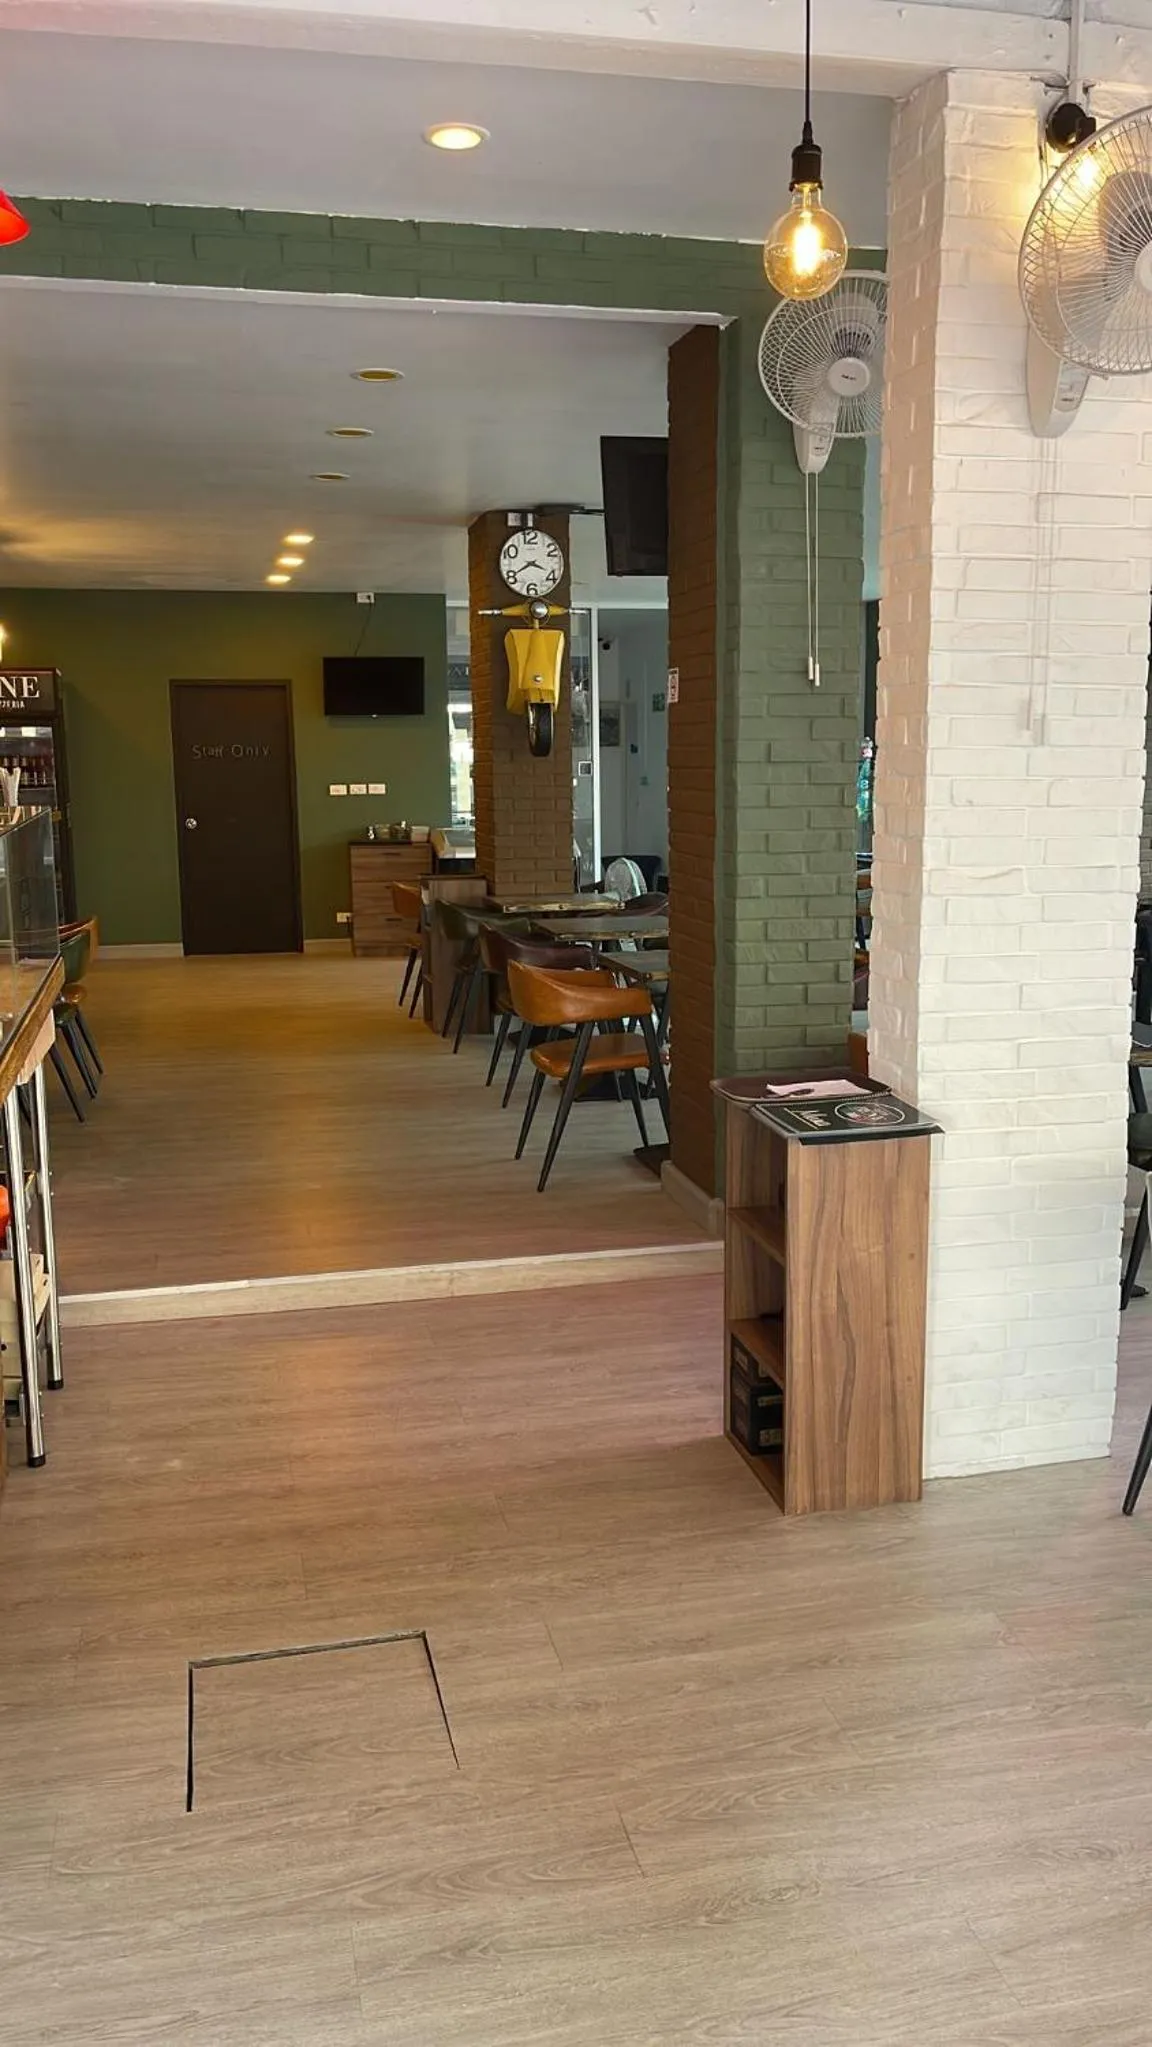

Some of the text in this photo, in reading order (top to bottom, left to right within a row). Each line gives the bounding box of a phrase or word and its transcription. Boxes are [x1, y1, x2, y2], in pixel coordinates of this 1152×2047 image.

[521, 530, 539, 545] 12
[503, 544, 519, 560] 10
[546, 542, 558, 558] 2
[506, 570, 518, 585] 8
[545, 569, 559, 585] 4
[526, 582, 539, 596] 6
[231, 744, 271, 761] Only
